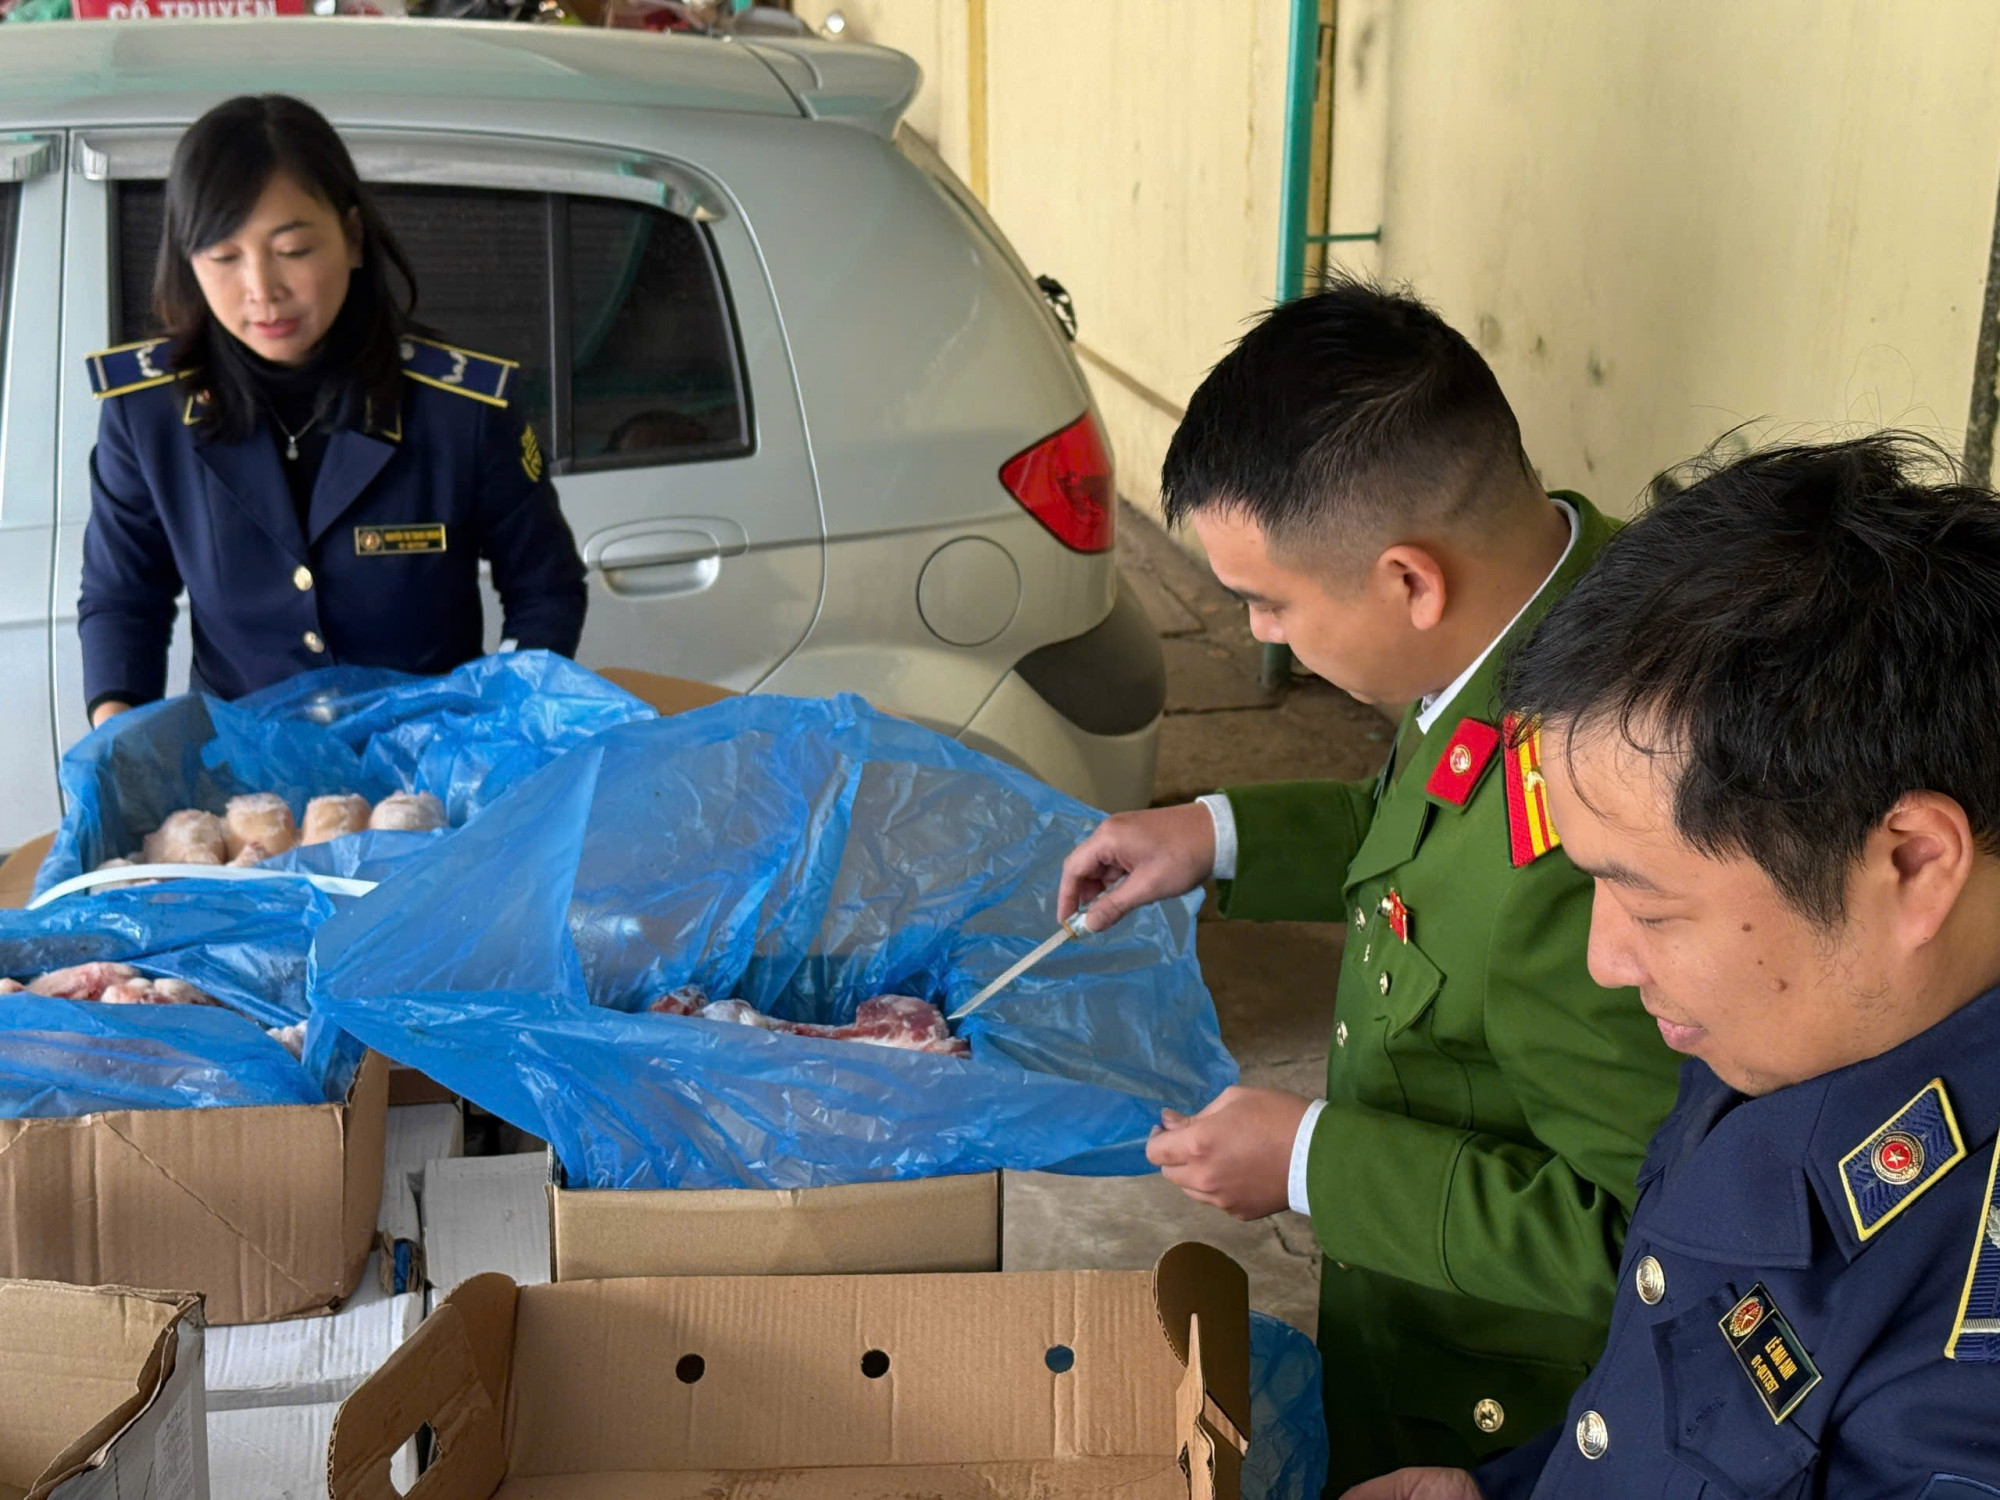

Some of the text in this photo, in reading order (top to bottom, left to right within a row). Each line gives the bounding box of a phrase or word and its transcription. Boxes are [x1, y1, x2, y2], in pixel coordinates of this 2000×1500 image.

[1764, 1336, 1797, 1381] LÊ MAI ANH
